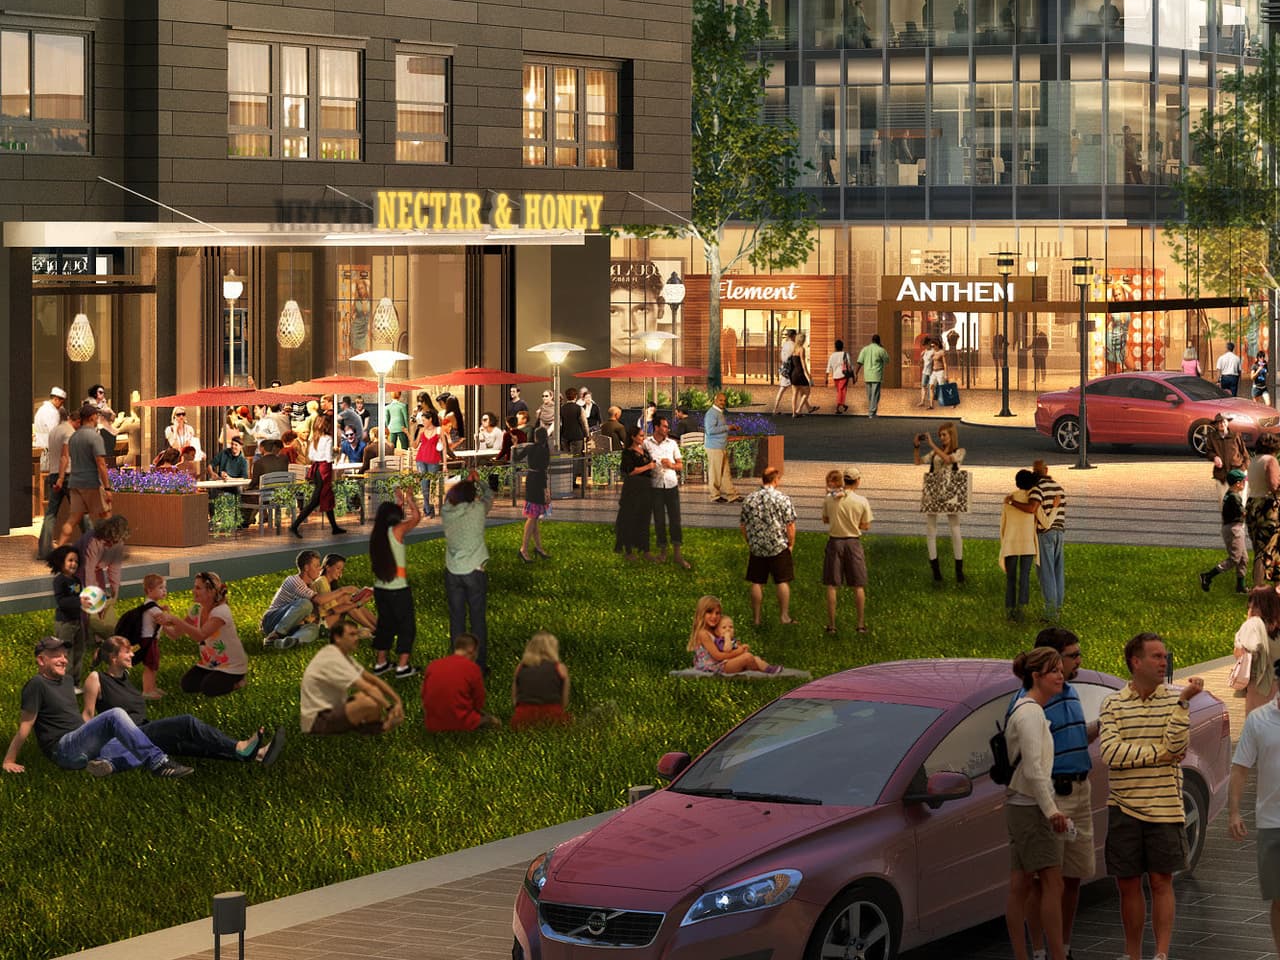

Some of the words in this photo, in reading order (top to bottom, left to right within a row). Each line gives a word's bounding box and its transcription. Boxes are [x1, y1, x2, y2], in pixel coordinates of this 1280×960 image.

[377, 191, 482, 230] NECTAR
[494, 193, 513, 230] &
[523, 194, 604, 230] HONEY
[719, 278, 801, 300] Element
[896, 276, 1015, 302] ANTHEM
